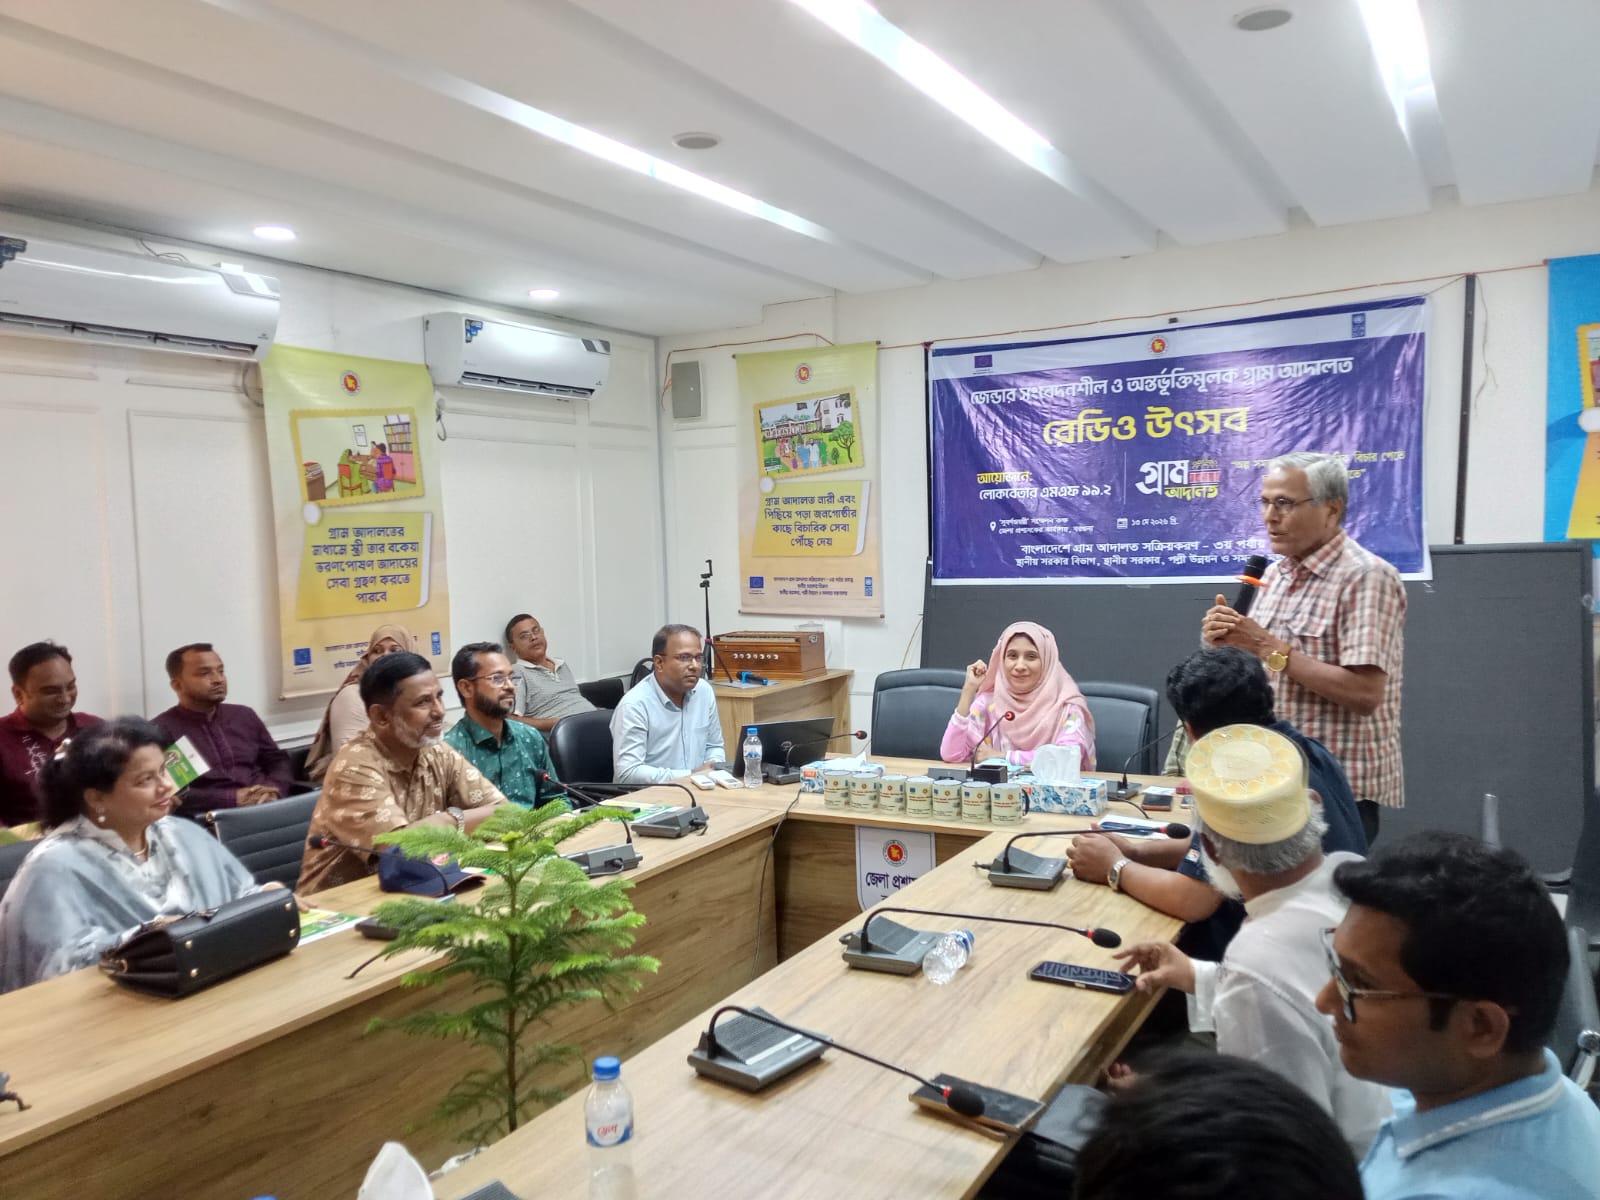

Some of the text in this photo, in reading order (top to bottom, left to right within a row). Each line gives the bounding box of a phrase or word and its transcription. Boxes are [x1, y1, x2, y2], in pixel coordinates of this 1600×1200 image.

[971, 388, 1016, 405] জেন্ডার
[1020, 376, 1108, 399] সংবেদনশীল
[1111, 378, 1123, 393] ও
[1243, 365, 1274, 386] গ্রাম
[1278, 357, 1354, 378] আদালত
[1042, 406, 1250, 447] রেডিও উৎসব
[1135, 460, 1190, 495] গ্রাম
[765, 492, 856, 506] গ্রাম আদালত নারী এবং
[980, 484, 1111, 500] লোকবেতার এমএফ ৯৯.২
[1164, 485, 1219, 500] আদালত
[765, 506, 857, 520] পিছিয়ে পড়া জনগোষ্ঠীর
[328, 527, 404, 539] গ্রাম আদালতের
[772, 521, 849, 534] কাছে বিচারিক সেবা
[312, 544, 347, 556] মাধ্যমে
[367, 543, 385, 554] তার
[388, 542, 419, 553] বকেয়া
[817, 538, 832, 546] দেয়
[1020, 544, 1071, 554] বাংলাদেশে
[1072, 544, 1093, 553] গ্রাম
[1096, 543, 1140, 552] আদালত
[1142, 539, 1201, 552] সক্রিয়করণ
[1213, 540, 1232, 550] ৩য়
[315, 558, 418, 573] ভরণপোষণ আদায়ের
[1015, 556, 1038, 568] স্থানীয়
[1041, 557, 1069, 566] সরকার
[1103, 555, 1128, 567] স্থানীয়
[1221, 554, 1230, 562] ও
[327, 574, 410, 589] সেবা গ্রহণ করতে
[355, 591, 387, 603] পারবে
[866, 872, 889, 889] জেলা
